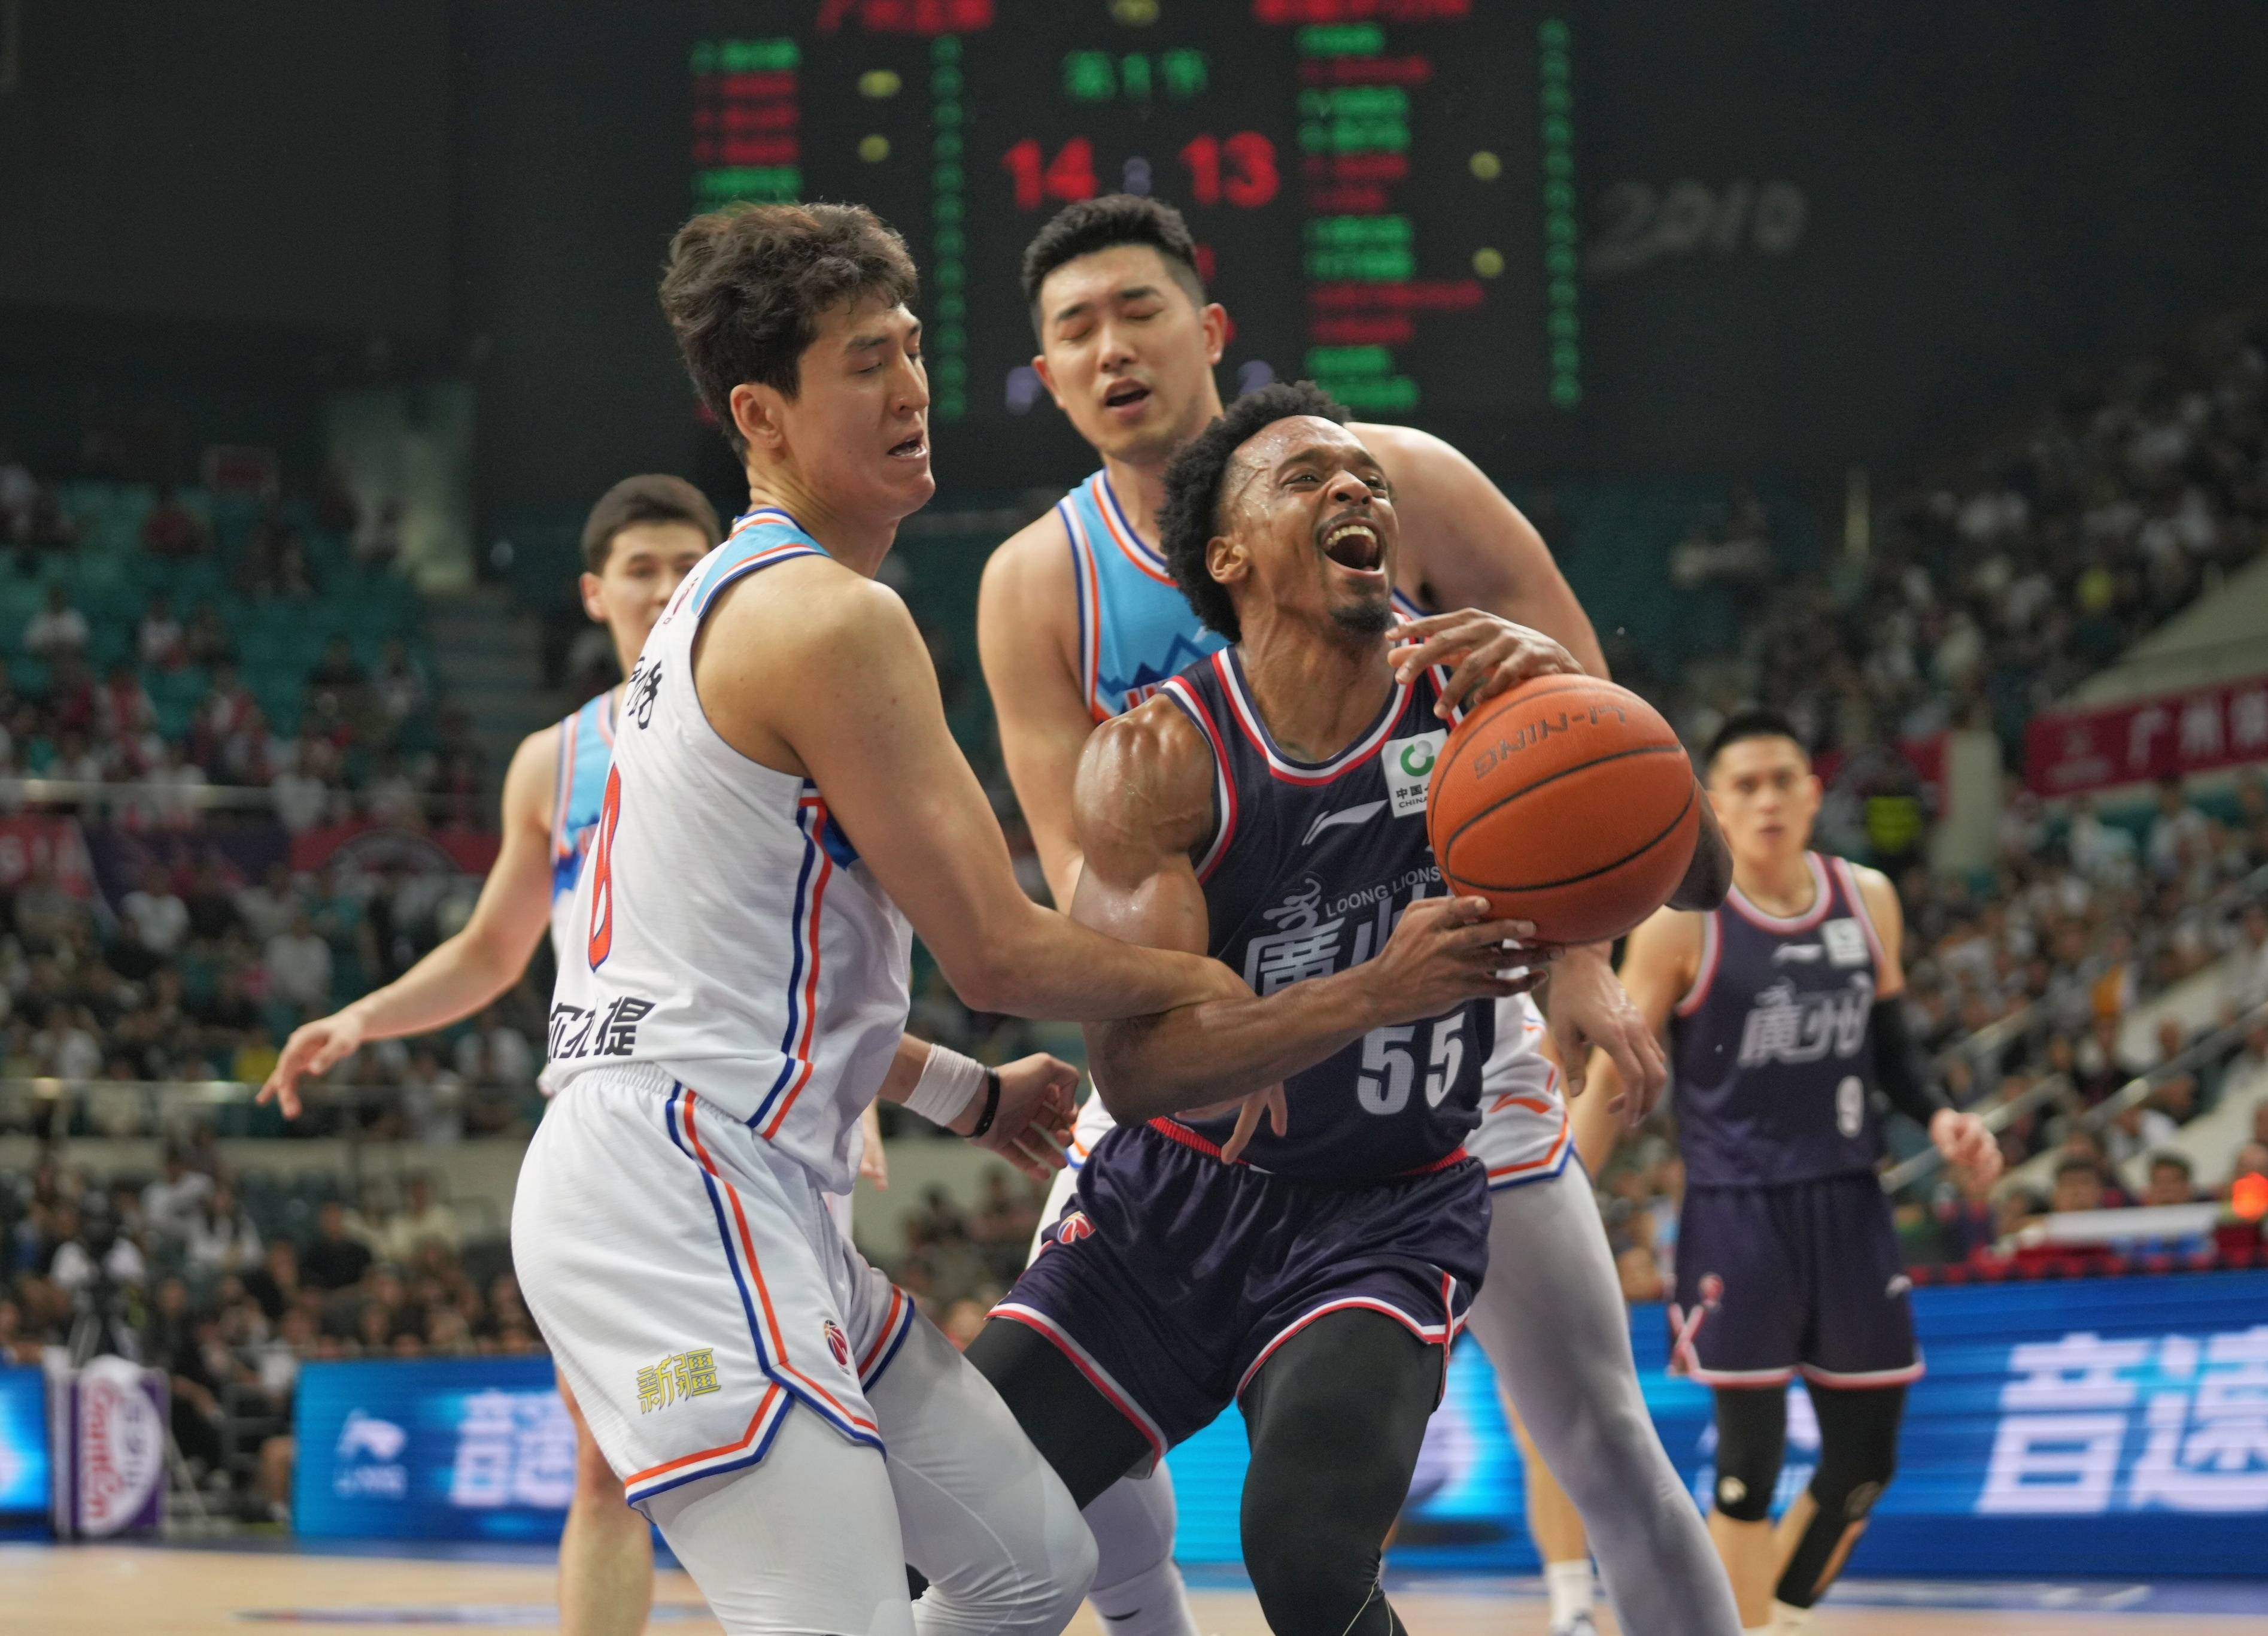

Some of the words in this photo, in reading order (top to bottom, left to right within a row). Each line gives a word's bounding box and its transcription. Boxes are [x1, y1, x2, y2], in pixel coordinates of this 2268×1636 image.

[1002, 136, 1098, 210] 14
[1178, 130, 1280, 207] 13
[1474, 705, 1626, 780] LI-NING
[1325, 885, 1389, 918] LOONG
[1392, 866, 1441, 894] LIONS
[1357, 1011, 1466, 1116] 55
[636, 1347, 722, 1415] 新疆
